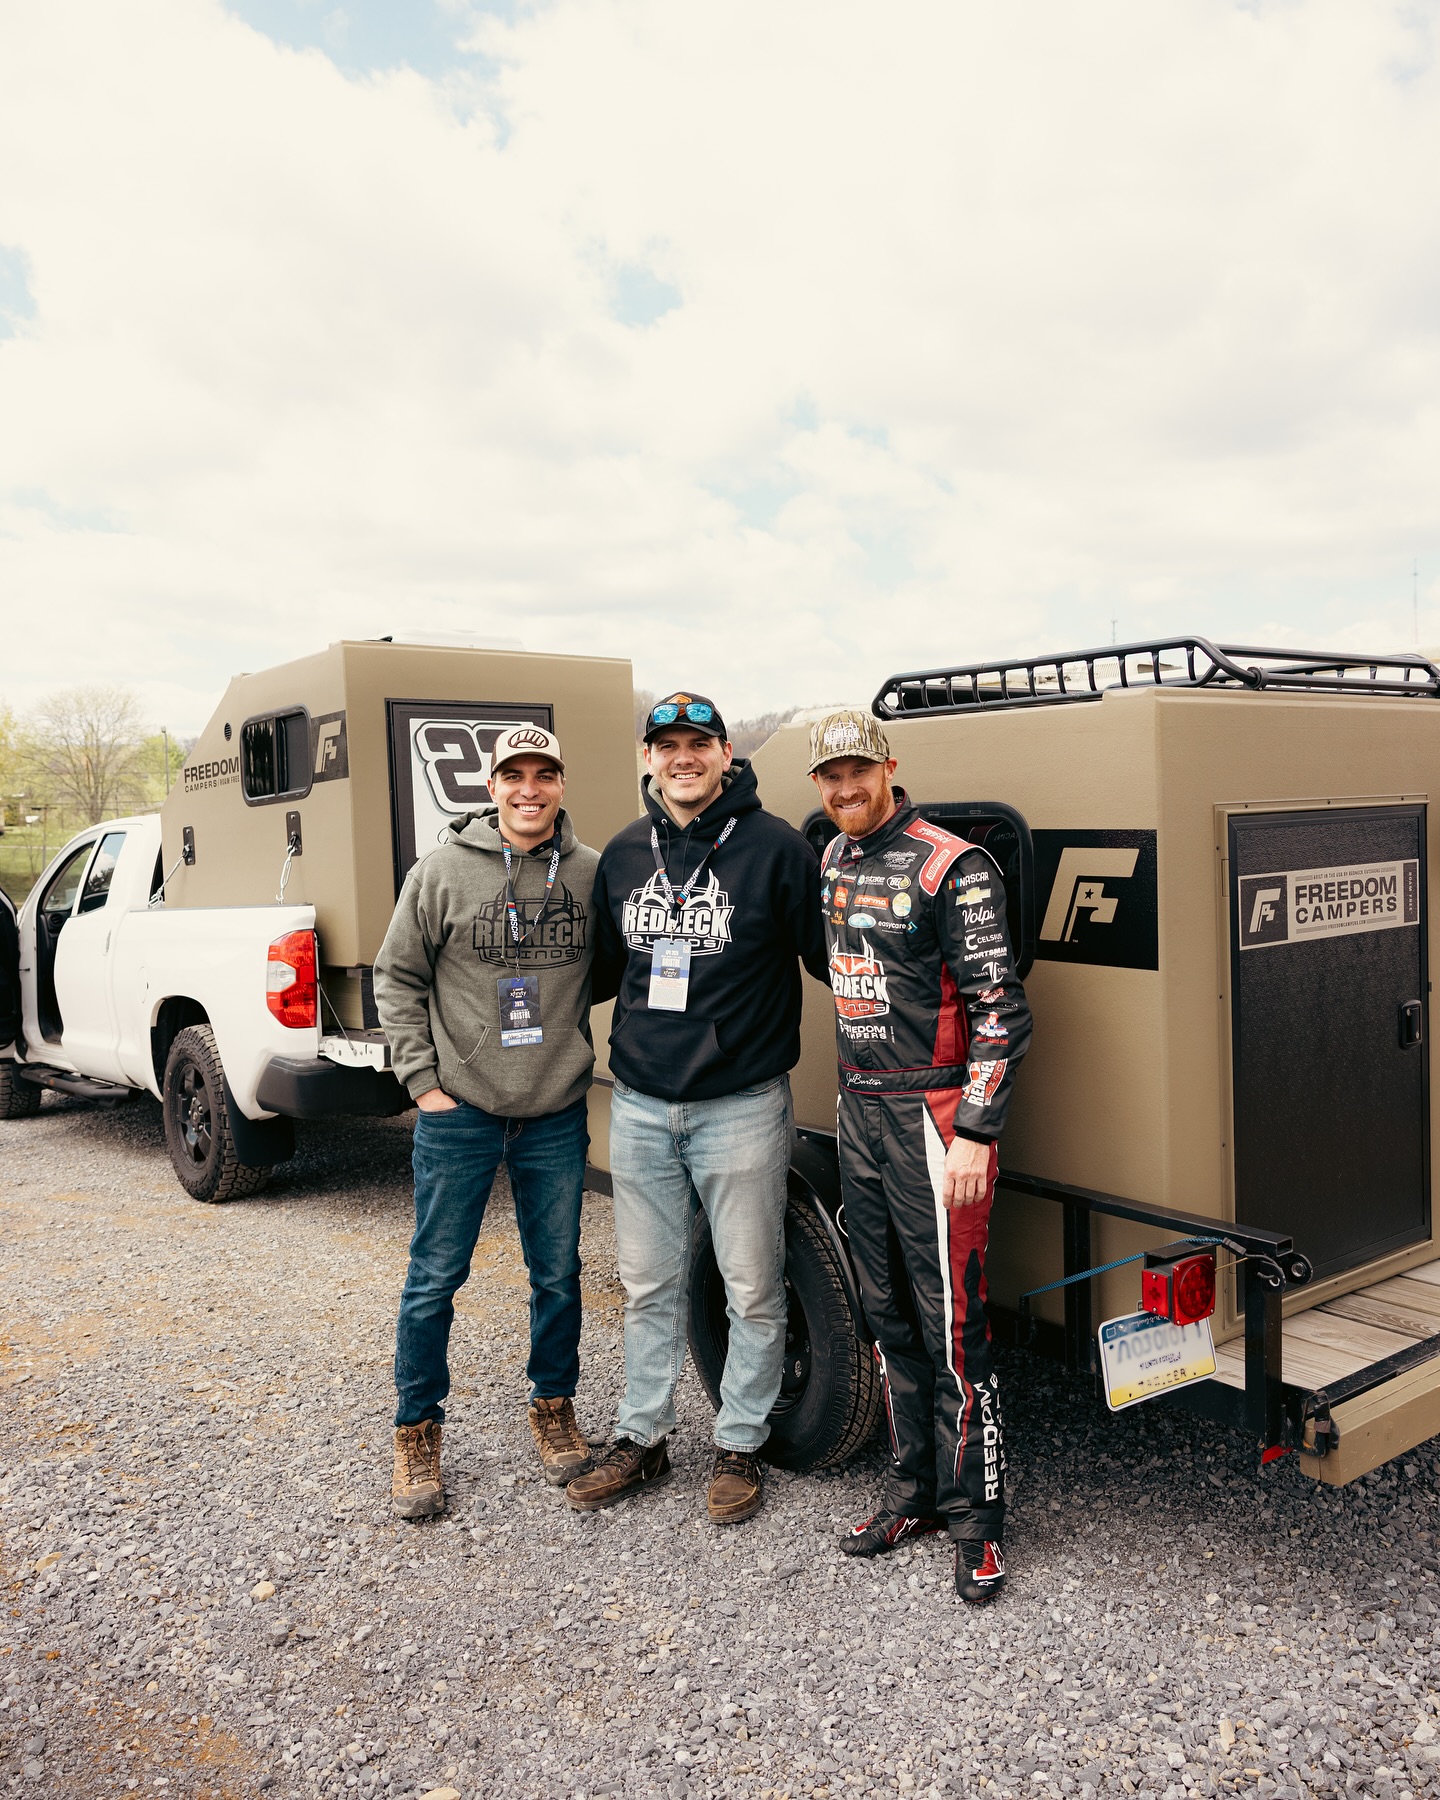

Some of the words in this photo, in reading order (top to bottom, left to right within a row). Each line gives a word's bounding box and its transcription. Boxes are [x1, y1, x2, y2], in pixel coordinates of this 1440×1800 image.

[184, 757, 240, 784] FREEDOM
[185, 780, 218, 793] CAMPERS
[719, 816, 738, 844] NASCAR
[547, 850, 561, 880] NASCAR
[927, 850, 948, 879] SIMPSON
[682, 867, 700, 897] NASCAR
[959, 871, 990, 887] NASCAR
[1295, 875, 1397, 906] FREEDOM
[858, 896, 887, 906] norma
[1295, 896, 1397, 925] CAMPERS
[877, 920, 907, 930] easycare
[962, 906, 995, 926] Volpi
[508, 911, 519, 942] NASCAR
[977, 932, 1003, 944] CELSIUS
[489, 949, 577, 960] BLINDS
[964, 946, 1007, 962] SPORTSMAN
[509, 1010, 531, 1021] BRISTOL
